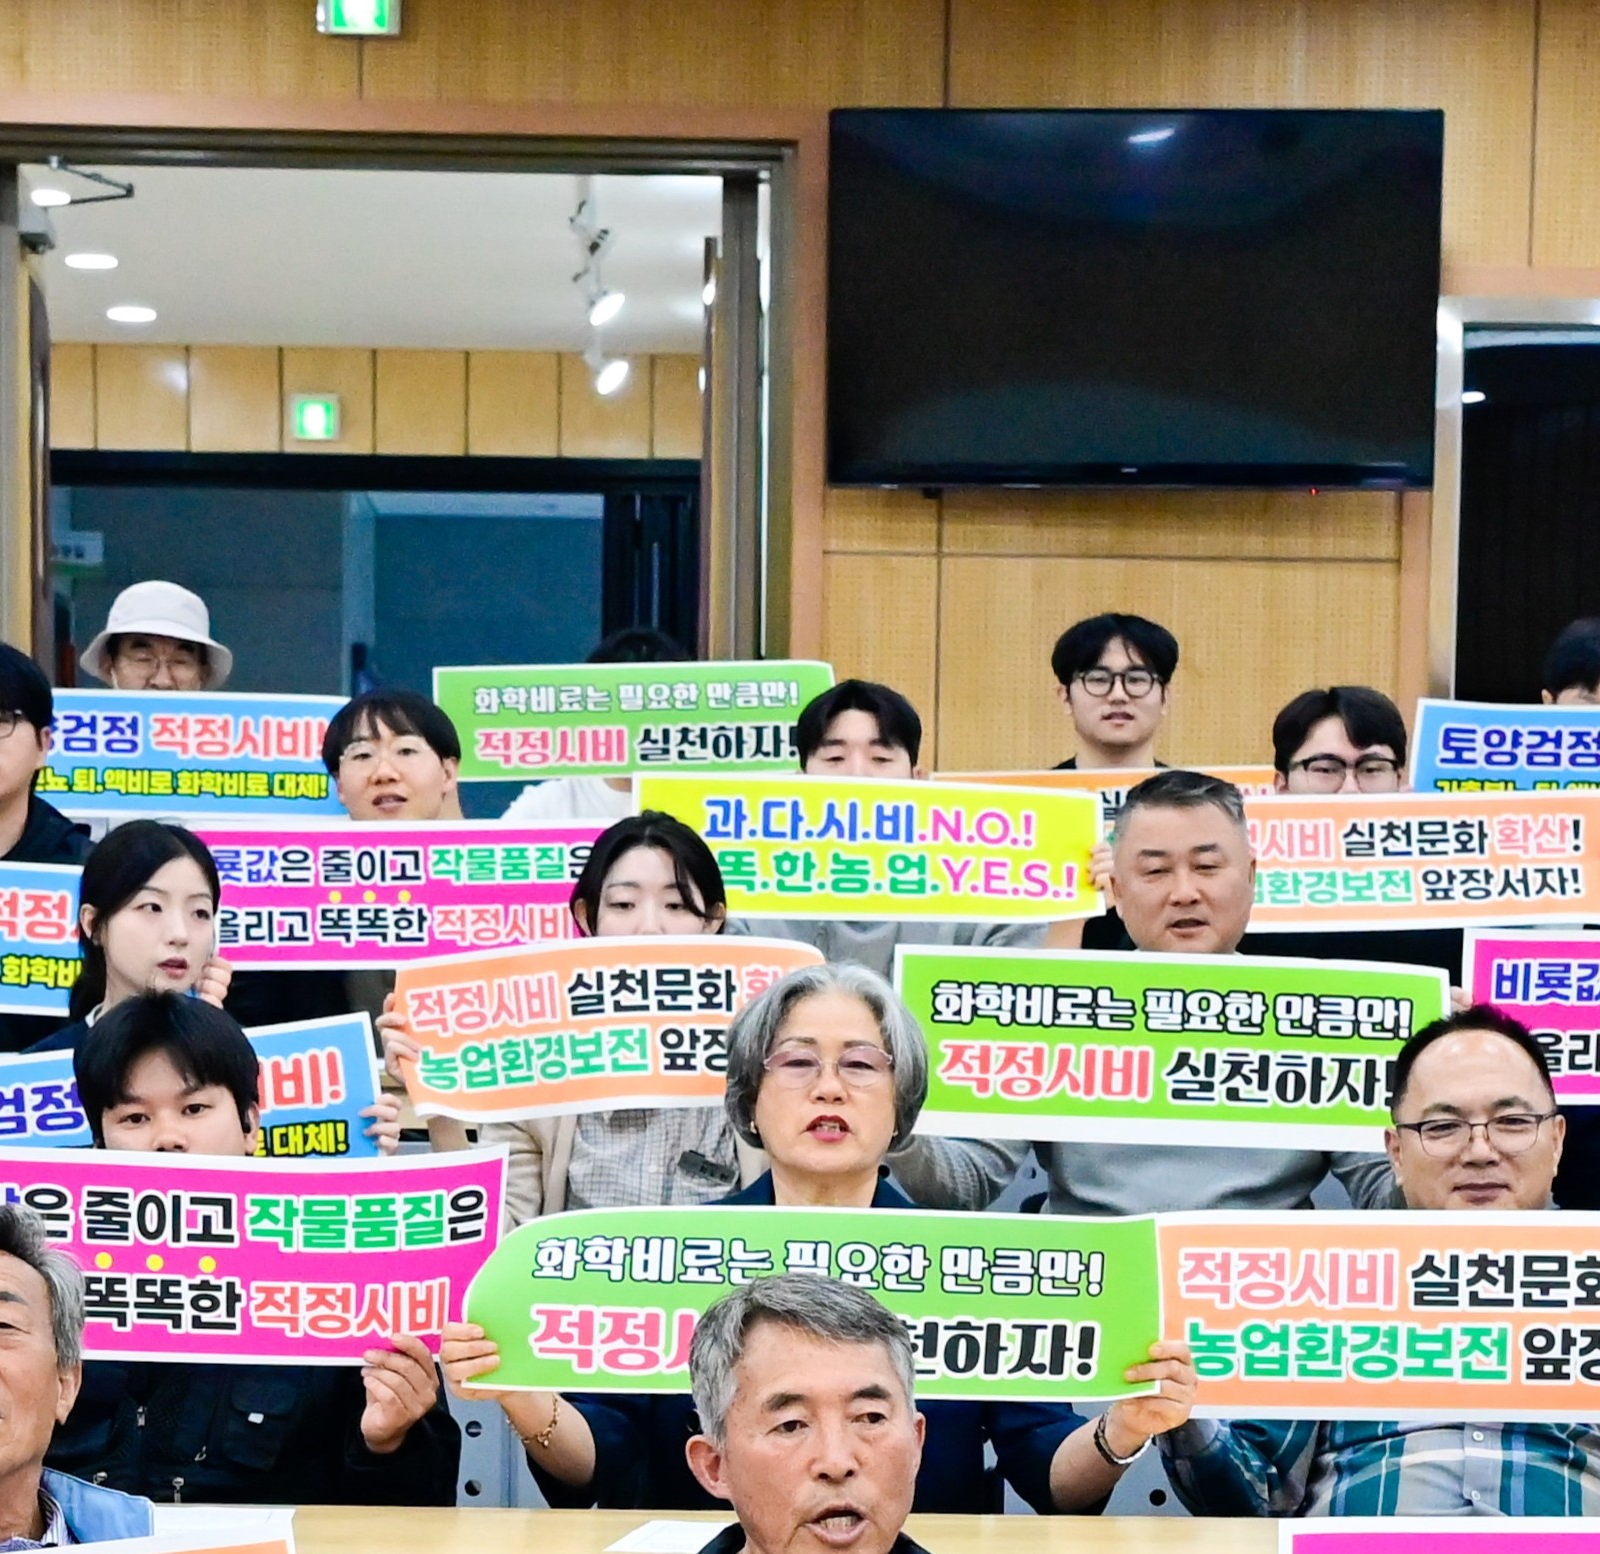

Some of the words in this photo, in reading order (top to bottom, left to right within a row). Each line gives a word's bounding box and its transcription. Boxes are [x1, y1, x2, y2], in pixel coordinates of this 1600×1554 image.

[474, 686, 612, 714] 화학비료는
[618, 683, 700, 711] 필요한
[706, 681, 798, 709] 만큼만!
[478, 728, 625, 764] 적정시비
[177, 771, 270, 796] 화학비료
[274, 774, 327, 799] 대체!
[705, 798, 1033, 847] 과.다.시.비.N.O.!
[1343, 820, 1487, 857] 실천문화
[1496, 816, 1582, 854] 확산!
[213, 851, 312, 883] 룟값은
[322, 849, 421, 883] 줄이고
[1422, 866, 1582, 900] 앞장서자!
[319, 908, 427, 944] 똑똑한
[435, 906, 569, 941] 적정시비
[409, 977, 556, 1031] 적정시비
[567, 968, 736, 1017] 실천문화
[933, 983, 1135, 1029] 화학비료는
[1143, 990, 1266, 1035] 필요한
[1275, 997, 1412, 1040] 만큼만!
[420, 1025, 649, 1090] 농업환경보전
[941, 1043, 1151, 1099] 적정시비
[273, 1122, 347, 1156] 대체!
[83, 1189, 235, 1244] 줄이고
[247, 1189, 485, 1250] 작물품질은
[534, 1238, 772, 1286] 화학비료는
[941, 1245, 1103, 1296] 만큼만!
[1179, 1251, 1395, 1308] 적정시비
[251, 1281, 445, 1336] 적정시비
[1188, 1320, 1508, 1381] 농업환경보전
